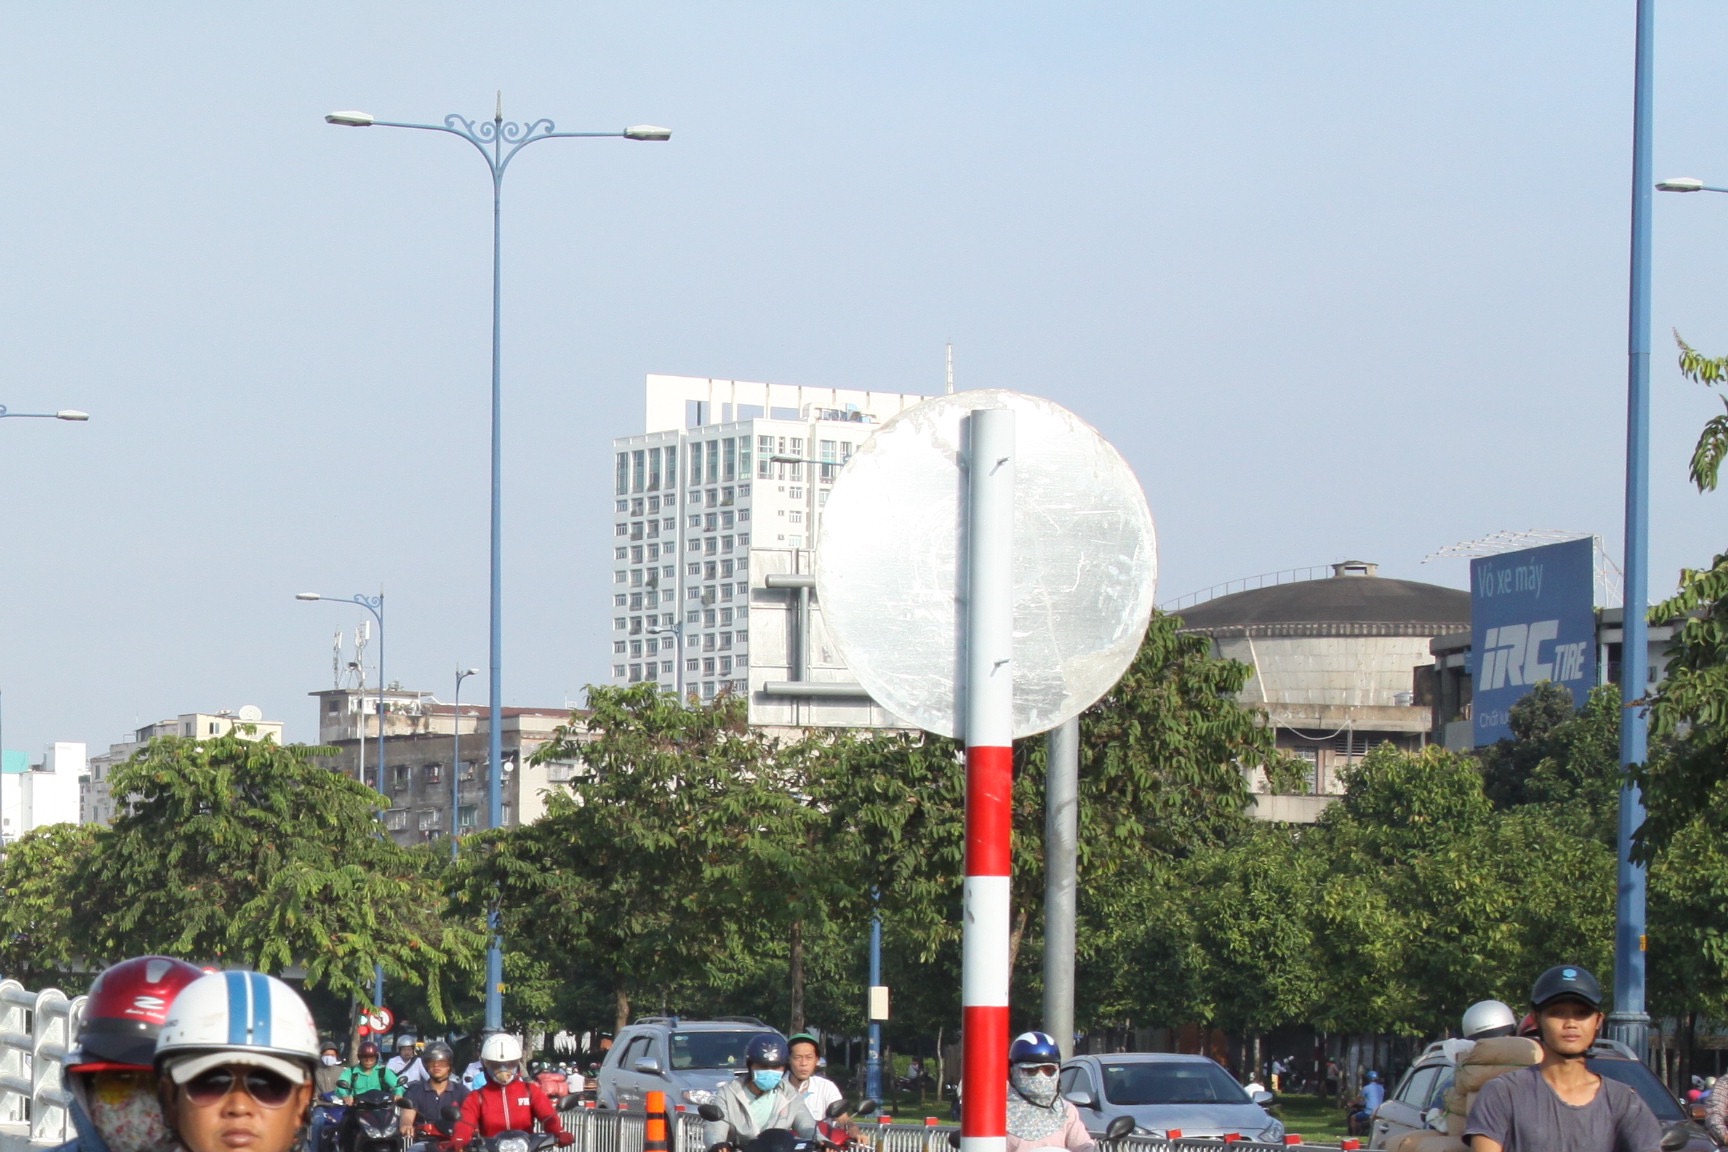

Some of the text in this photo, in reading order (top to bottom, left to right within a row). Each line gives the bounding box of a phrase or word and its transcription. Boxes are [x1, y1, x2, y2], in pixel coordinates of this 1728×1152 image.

[1478, 556, 1544, 599] Vỏ xe máy
[1554, 641, 1587, 682] TIRE
